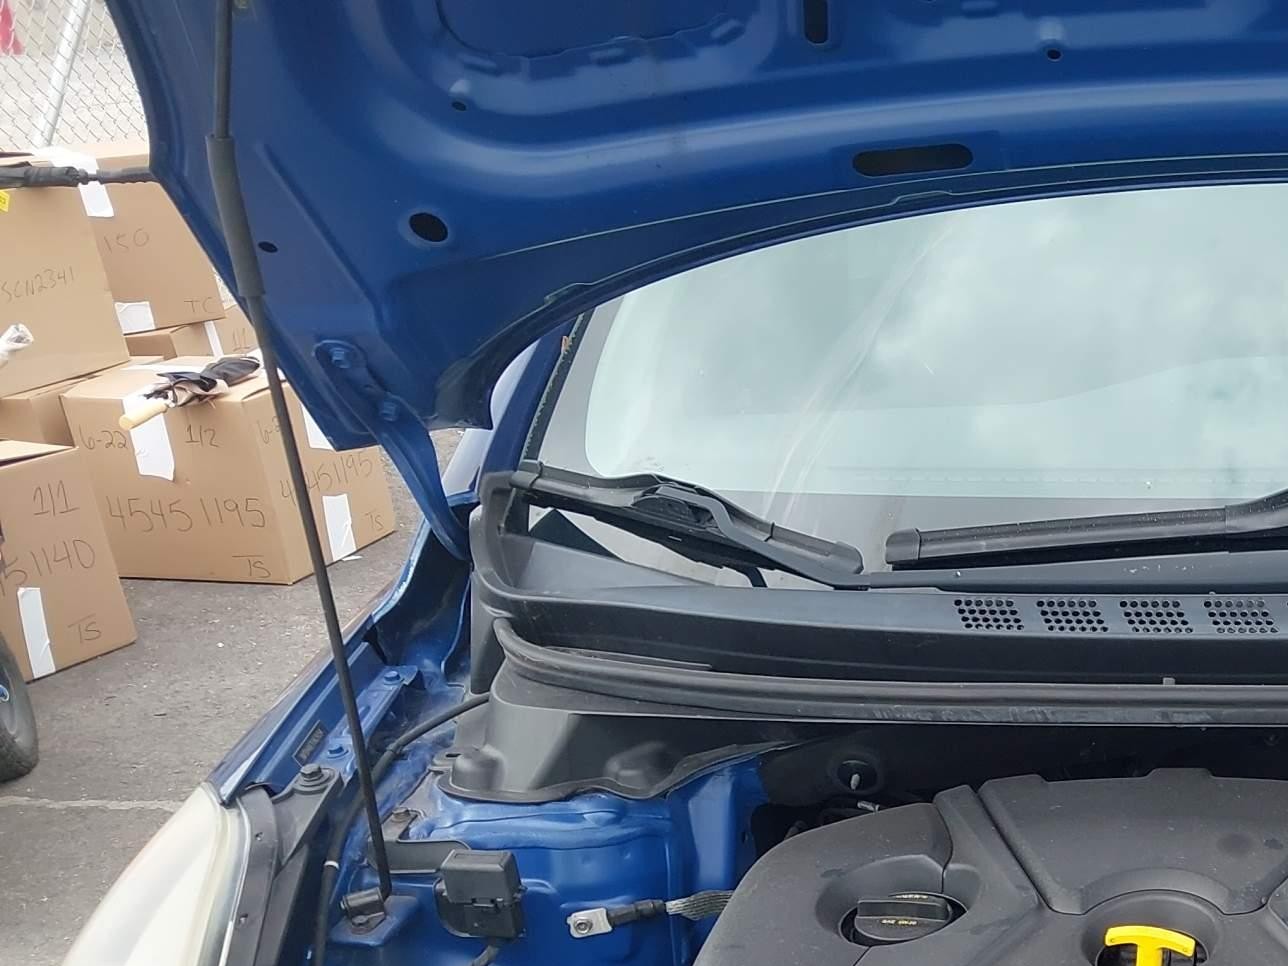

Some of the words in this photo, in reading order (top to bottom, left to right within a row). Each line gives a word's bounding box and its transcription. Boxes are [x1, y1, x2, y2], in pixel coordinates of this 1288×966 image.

[79, 425, 129, 450] 6-22
[184, 424, 220, 448] 1/2
[32, 480, 80, 517] 1/1
[232, 555, 272, 578] TS
[68, 614, 102, 644] TS
